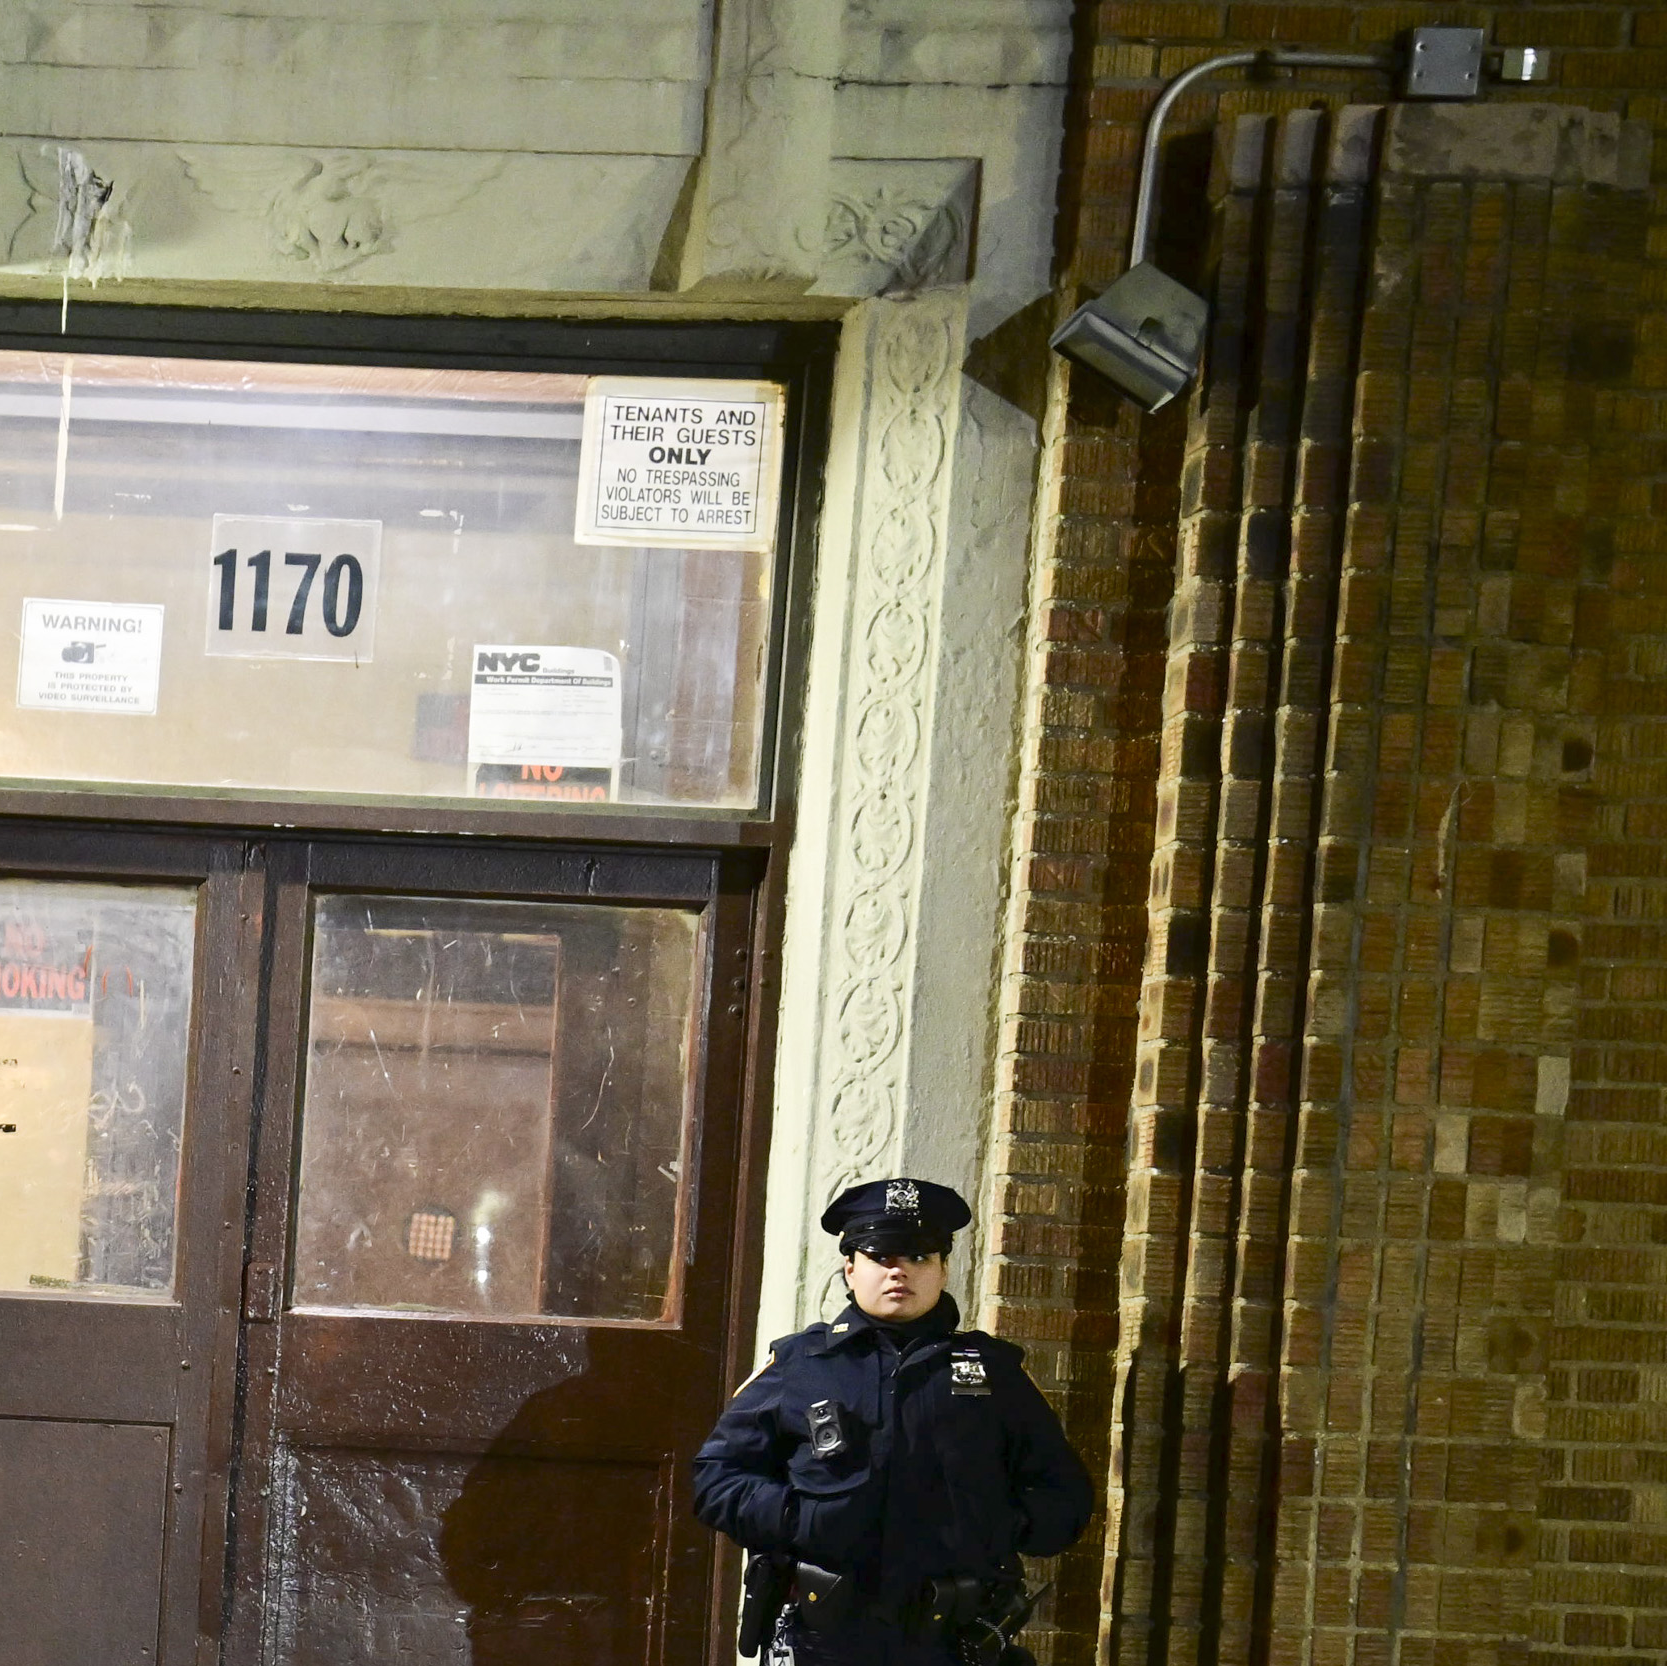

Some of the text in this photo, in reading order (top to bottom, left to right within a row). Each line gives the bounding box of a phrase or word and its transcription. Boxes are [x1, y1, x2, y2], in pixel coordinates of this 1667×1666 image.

[613, 405, 756, 426] TENANTS AND
[610, 425, 756, 446] THEIR GUESTS
[648, 447, 712, 465] ONLY
[617, 468, 740, 488] NO TRESPASSING
[606, 486, 750, 506] VIOLATORS WILL BE
[601, 504, 752, 525] SUBJECT TO ARREST
[213, 548, 363, 638] 1170
[42, 614, 142, 634] WARNING!
[477, 652, 541, 672] NYC
[542, 667, 575, 675] Buildings
[54, 671, 128, 683] THIS PROPERTY
[486, 676, 612, 687] Work Permit Department Of Buildings
[60, 682, 116, 693] PROTECTED
[120, 685, 133, 693] BY
[38, 692, 140, 705] VIDEO SURVEILLANCE
